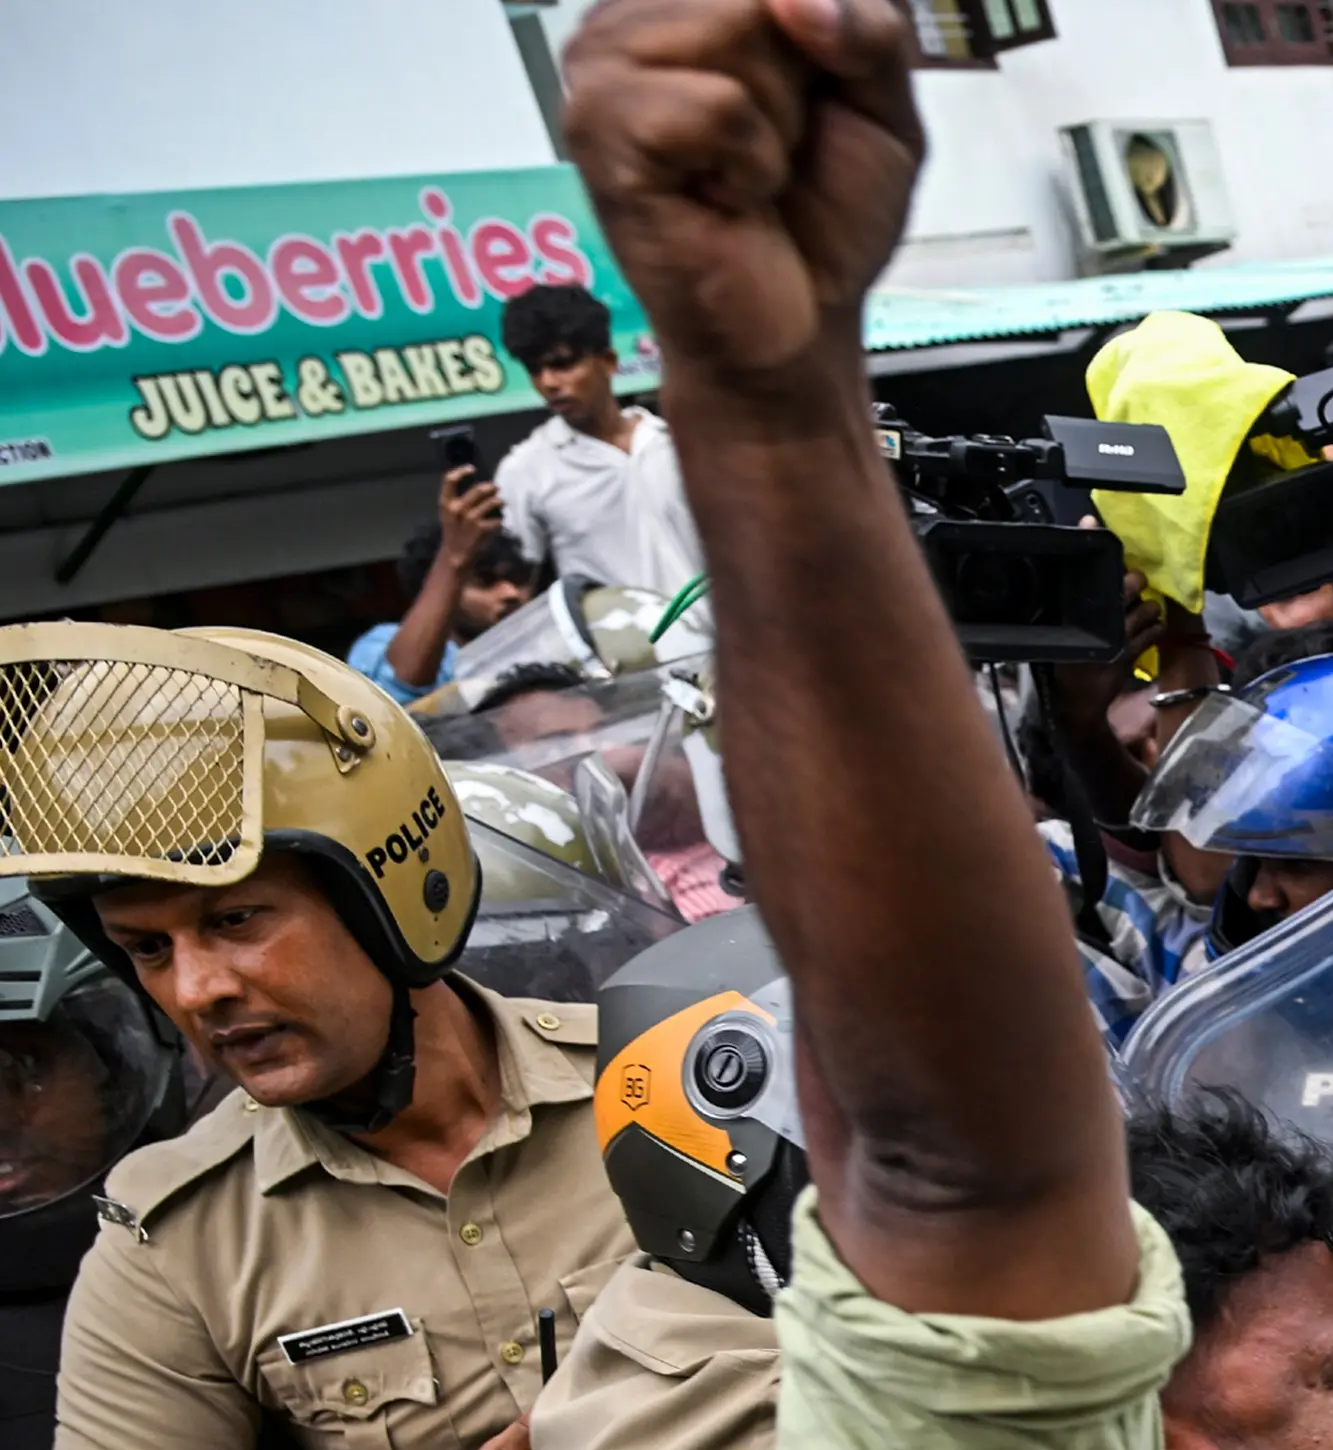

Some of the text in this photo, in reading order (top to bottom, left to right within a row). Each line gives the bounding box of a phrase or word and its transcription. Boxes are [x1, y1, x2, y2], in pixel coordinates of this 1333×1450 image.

[0, 187, 590, 357] lueberries
[131, 335, 505, 438] JUICE & BAKES
[365, 785, 446, 880] POLICE
